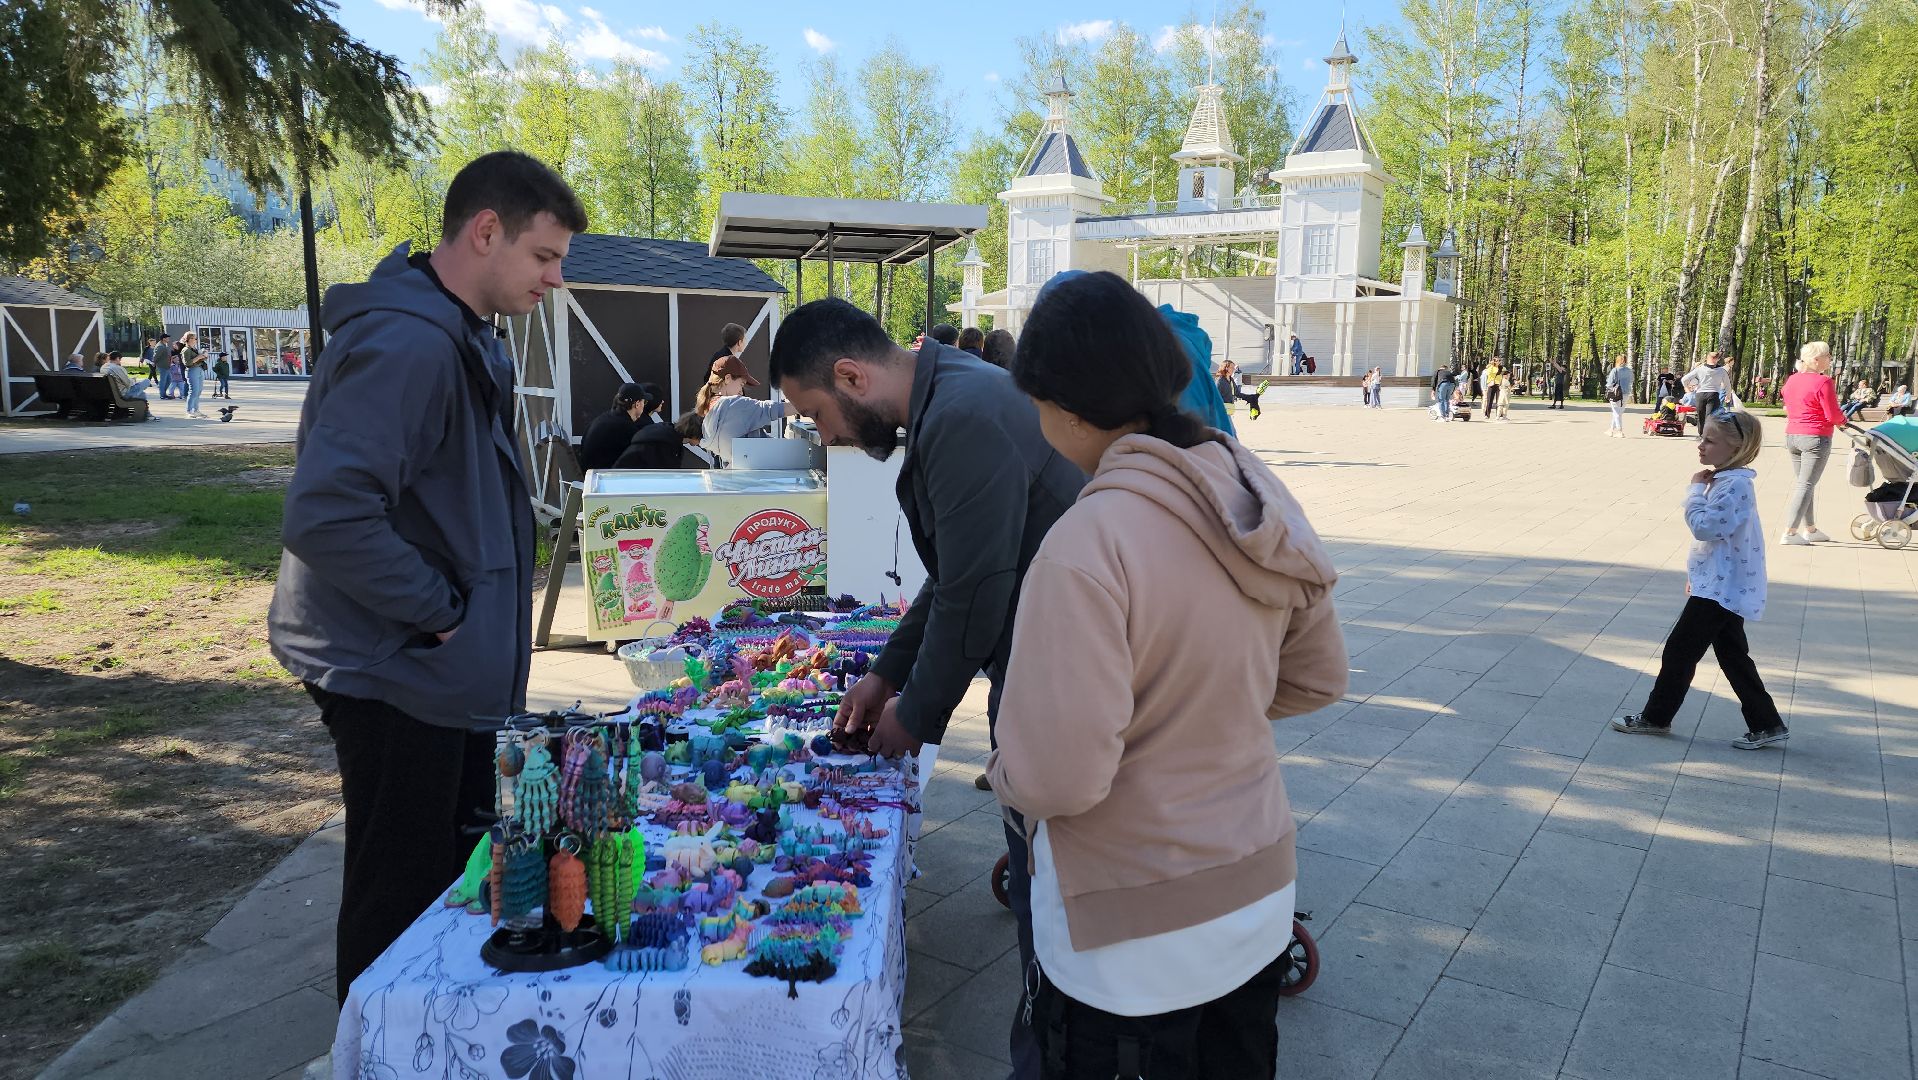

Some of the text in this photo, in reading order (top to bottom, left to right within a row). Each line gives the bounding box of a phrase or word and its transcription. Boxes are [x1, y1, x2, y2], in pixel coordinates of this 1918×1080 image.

[600, 504, 667, 539] КАКТУС
[746, 517, 797, 534] ПРОДУКТ
[715, 528, 827, 566] Чистая
[728, 549, 827, 587] Линия
[751, 581, 780, 593] trade
